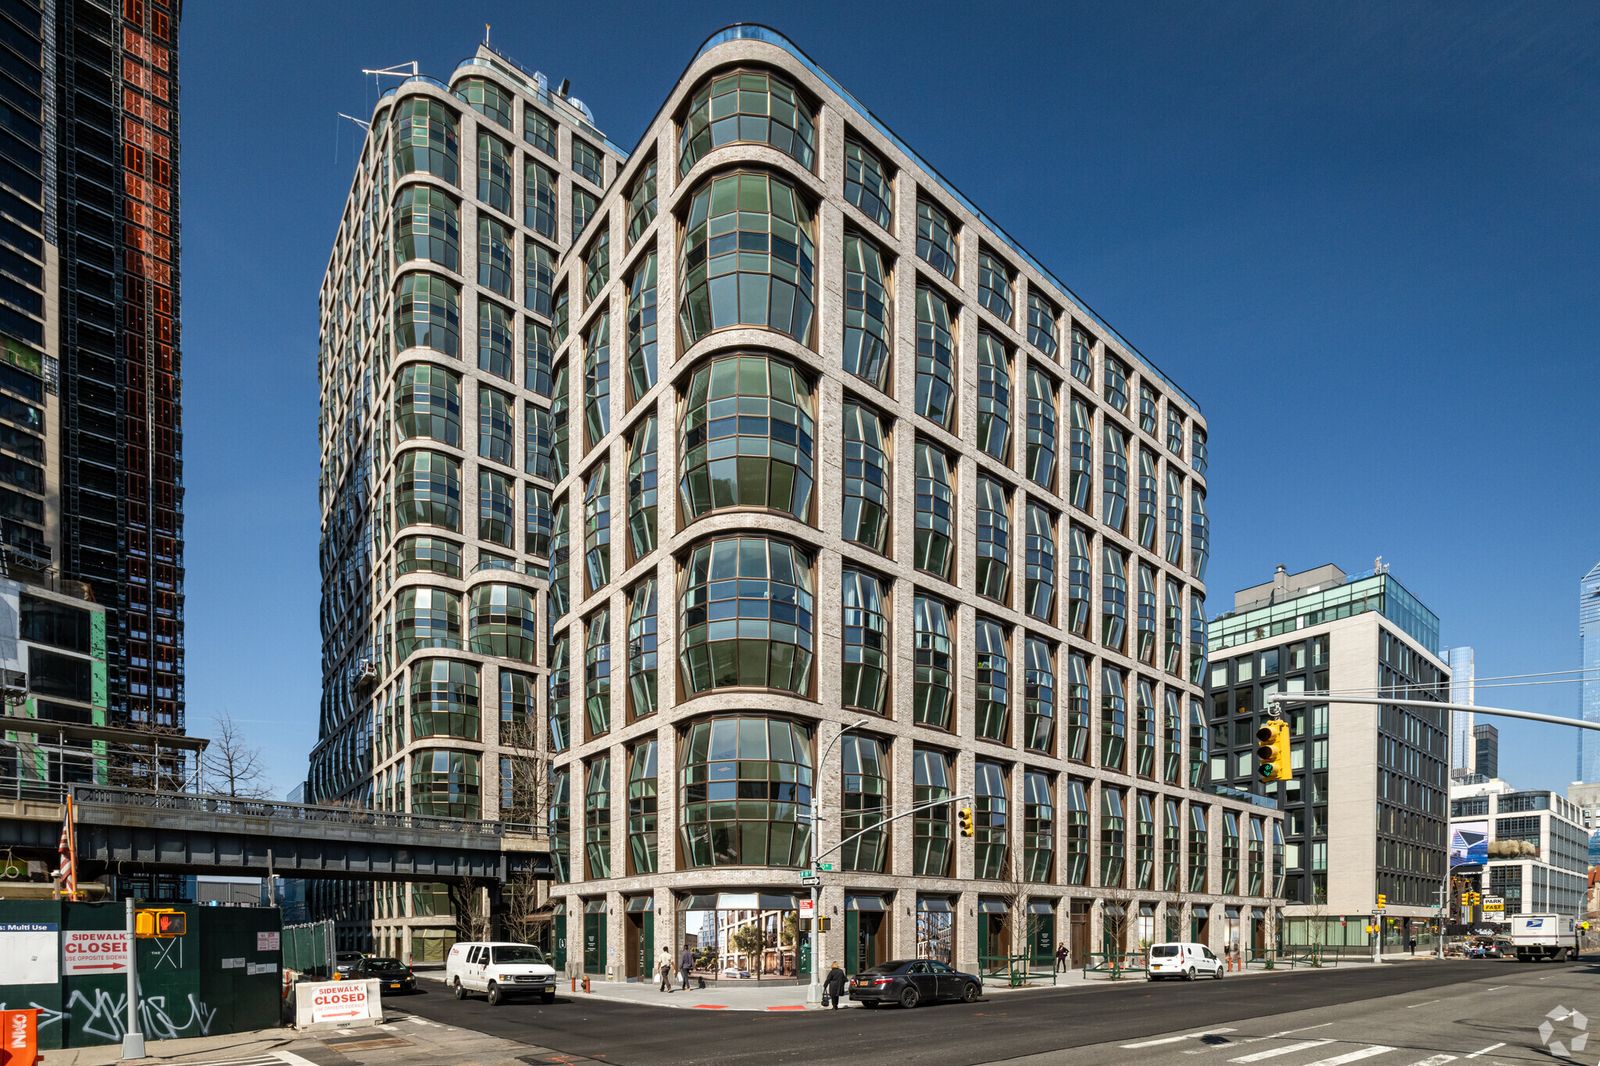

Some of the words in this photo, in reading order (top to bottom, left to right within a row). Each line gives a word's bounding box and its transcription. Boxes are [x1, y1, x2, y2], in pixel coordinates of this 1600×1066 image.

[72, 933, 126, 941] SIDEWALK
[319, 986, 359, 994] SIDEWALK
[314, 993, 365, 1005] CLOSED
